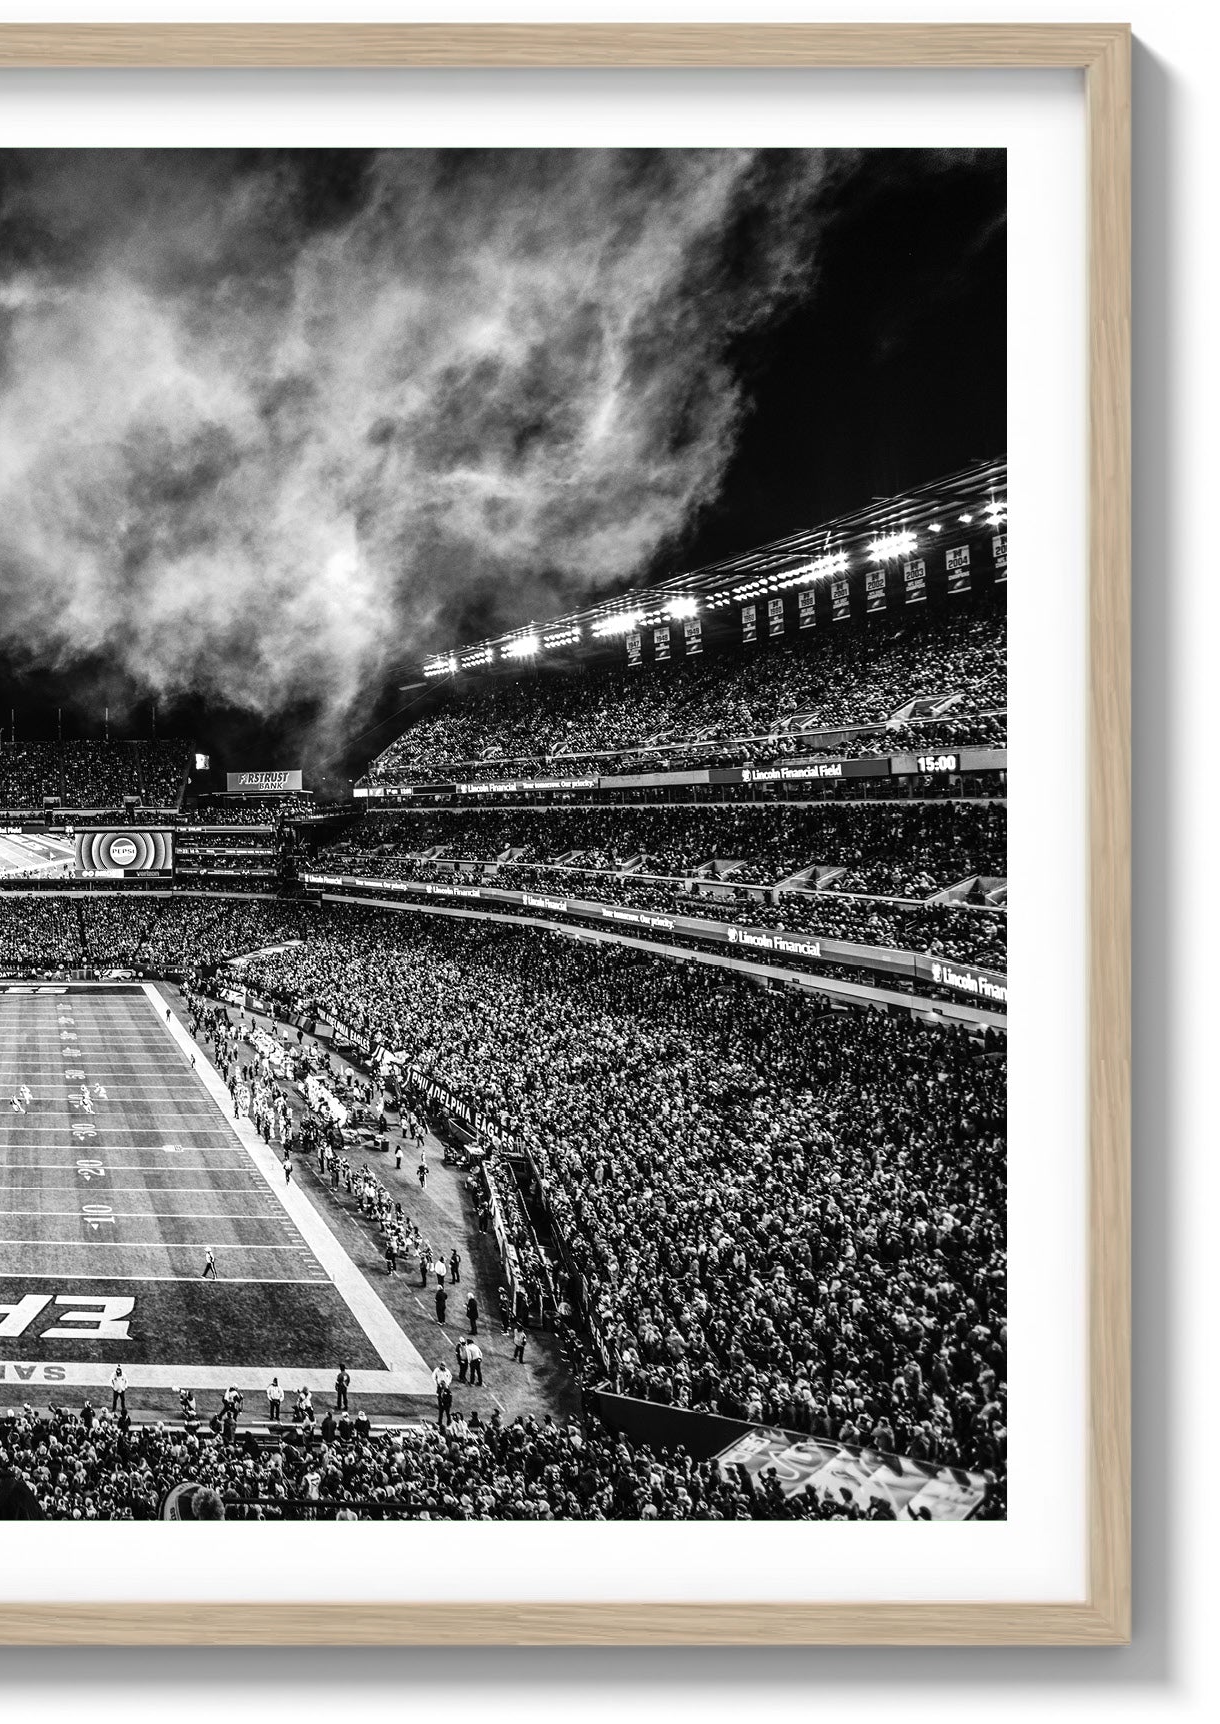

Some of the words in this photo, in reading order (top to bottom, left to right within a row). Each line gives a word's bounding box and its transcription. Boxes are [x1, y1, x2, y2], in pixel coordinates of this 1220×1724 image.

[947, 555, 968, 569] 2004
[905, 568, 924, 580] 2003
[867, 579, 885, 590] 2002
[917, 755, 956, 771] 15:00
[752, 769, 781, 780] Lincoln
[781, 766, 819, 778] Financial
[819, 764, 842, 776] Field
[260, 782, 283, 791] BANK
[467, 784, 488, 792] Lincoln
[489, 782, 517, 791] Financial
[7, 826, 22, 834] Field
[433, 886, 453, 895] Lincoln
[453, 888, 480, 897] Financial
[528, 896, 544, 907] Lincoln
[544, 898, 567, 912] Financial
[738, 931, 773, 948] Lincoln
[773, 937, 821, 957] Financial
[943, 967, 978, 993] Lincoln
[411, 1071, 472, 1123] PHILADELPHIA
[76, 1159, 106, 1177] 20
[82, 1204, 116, 1225] 10
